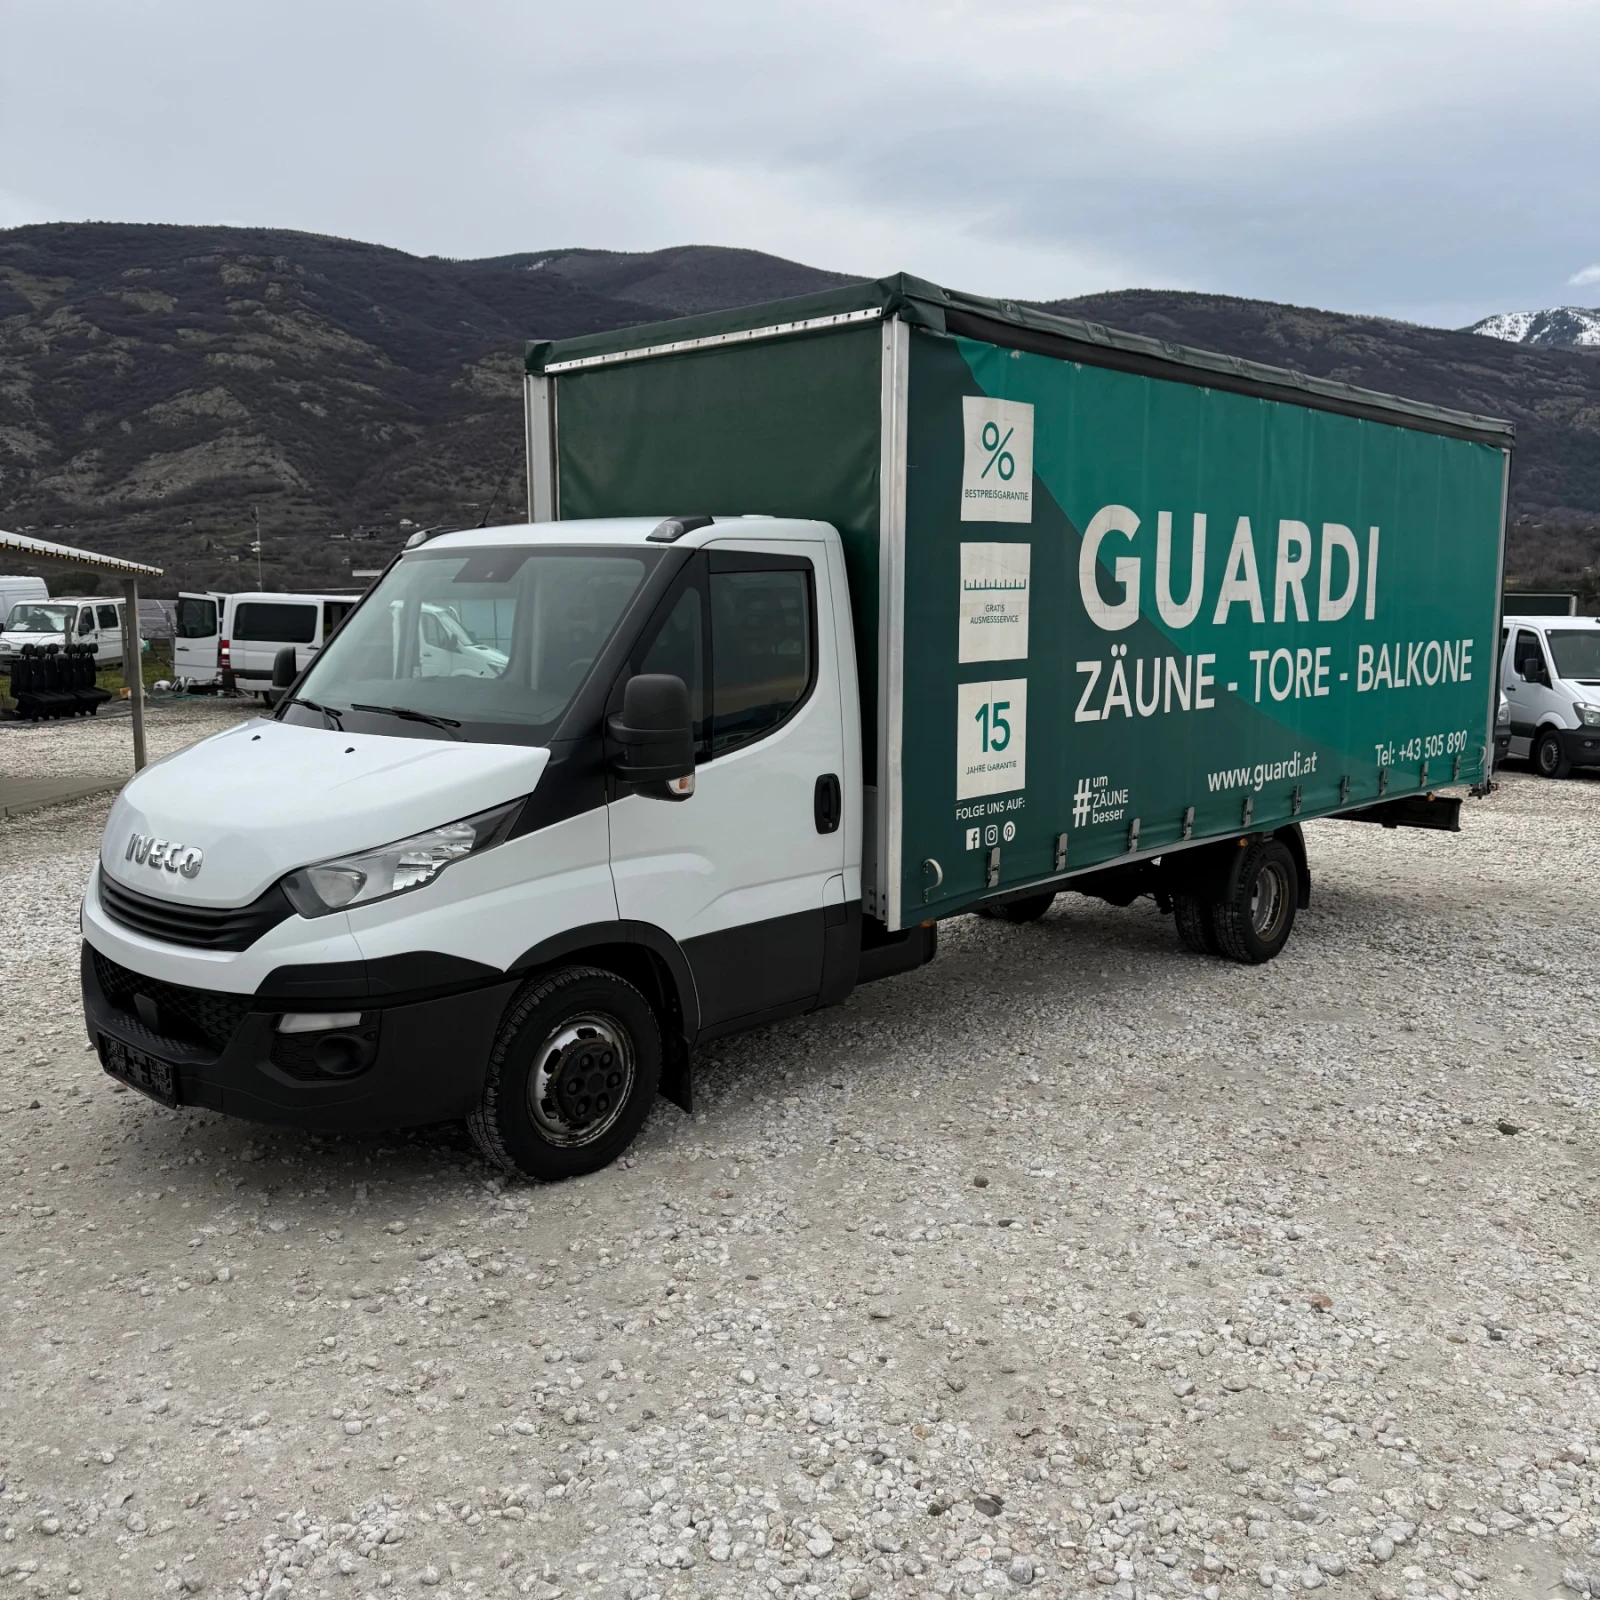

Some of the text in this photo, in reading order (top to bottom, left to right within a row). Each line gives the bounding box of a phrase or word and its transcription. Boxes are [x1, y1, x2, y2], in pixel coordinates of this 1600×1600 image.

[964, 488, 1029, 501] BESTPREISGARANTIE
[1079, 504, 1380, 631] GUARDI
[970, 614, 1019, 625] AUSMESSSERVICE
[985, 604, 1005, 613] GRATIS
[1074, 643, 1216, 723] ZÄUNE
[1249, 647, 1331, 703] TORE
[1357, 639, 1474, 692] BALKONE
[974, 701, 1011, 753] 15
[1374, 729, 1468, 767] Tel: +43 505 890
[966, 760, 1017, 775] JAHRE GARANTIE
[1207, 751, 1318, 792] www.guardi.at
[1092, 775, 1108, 788] um
[956, 797, 1025, 820] FOLGE UNS AUF:
[1092, 788, 1129, 809] ZÄUNE
[1092, 808, 1125, 825] besser
[125, 833, 204, 879] IVECO
